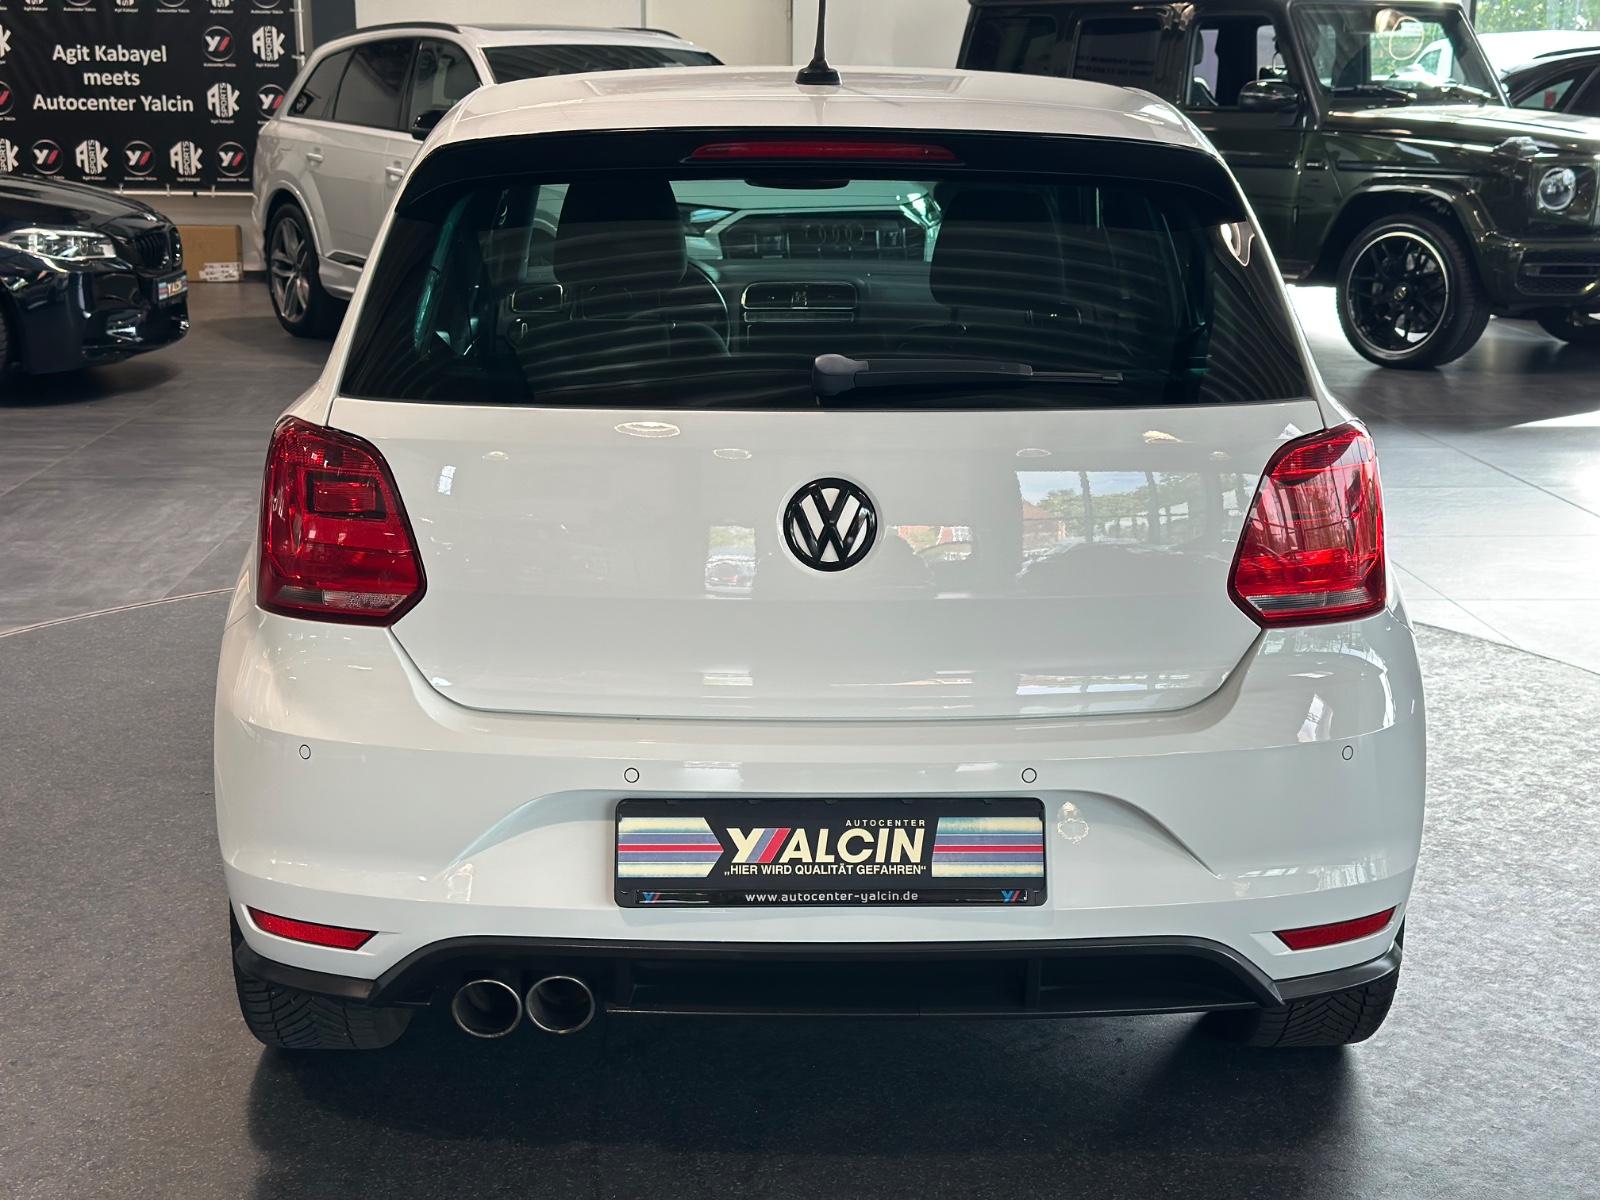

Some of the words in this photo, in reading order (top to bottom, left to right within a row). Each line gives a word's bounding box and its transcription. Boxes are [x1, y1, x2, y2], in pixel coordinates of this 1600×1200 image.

[52, 44, 91, 65] Agit
[94, 44, 167, 66] Kabayel
[83, 71, 141, 86] meets
[33, 94, 136, 112] Autocenter
[141, 95, 194, 113] Yalcin
[783, 478, 877, 572] VW
[845, 819, 926, 827] AUTOCENTER
[761, 864, 792, 875] WIRD
[795, 863, 852, 875] QUALITÄT
[745, 890, 919, 903] www.autocenter-yalcin.de
